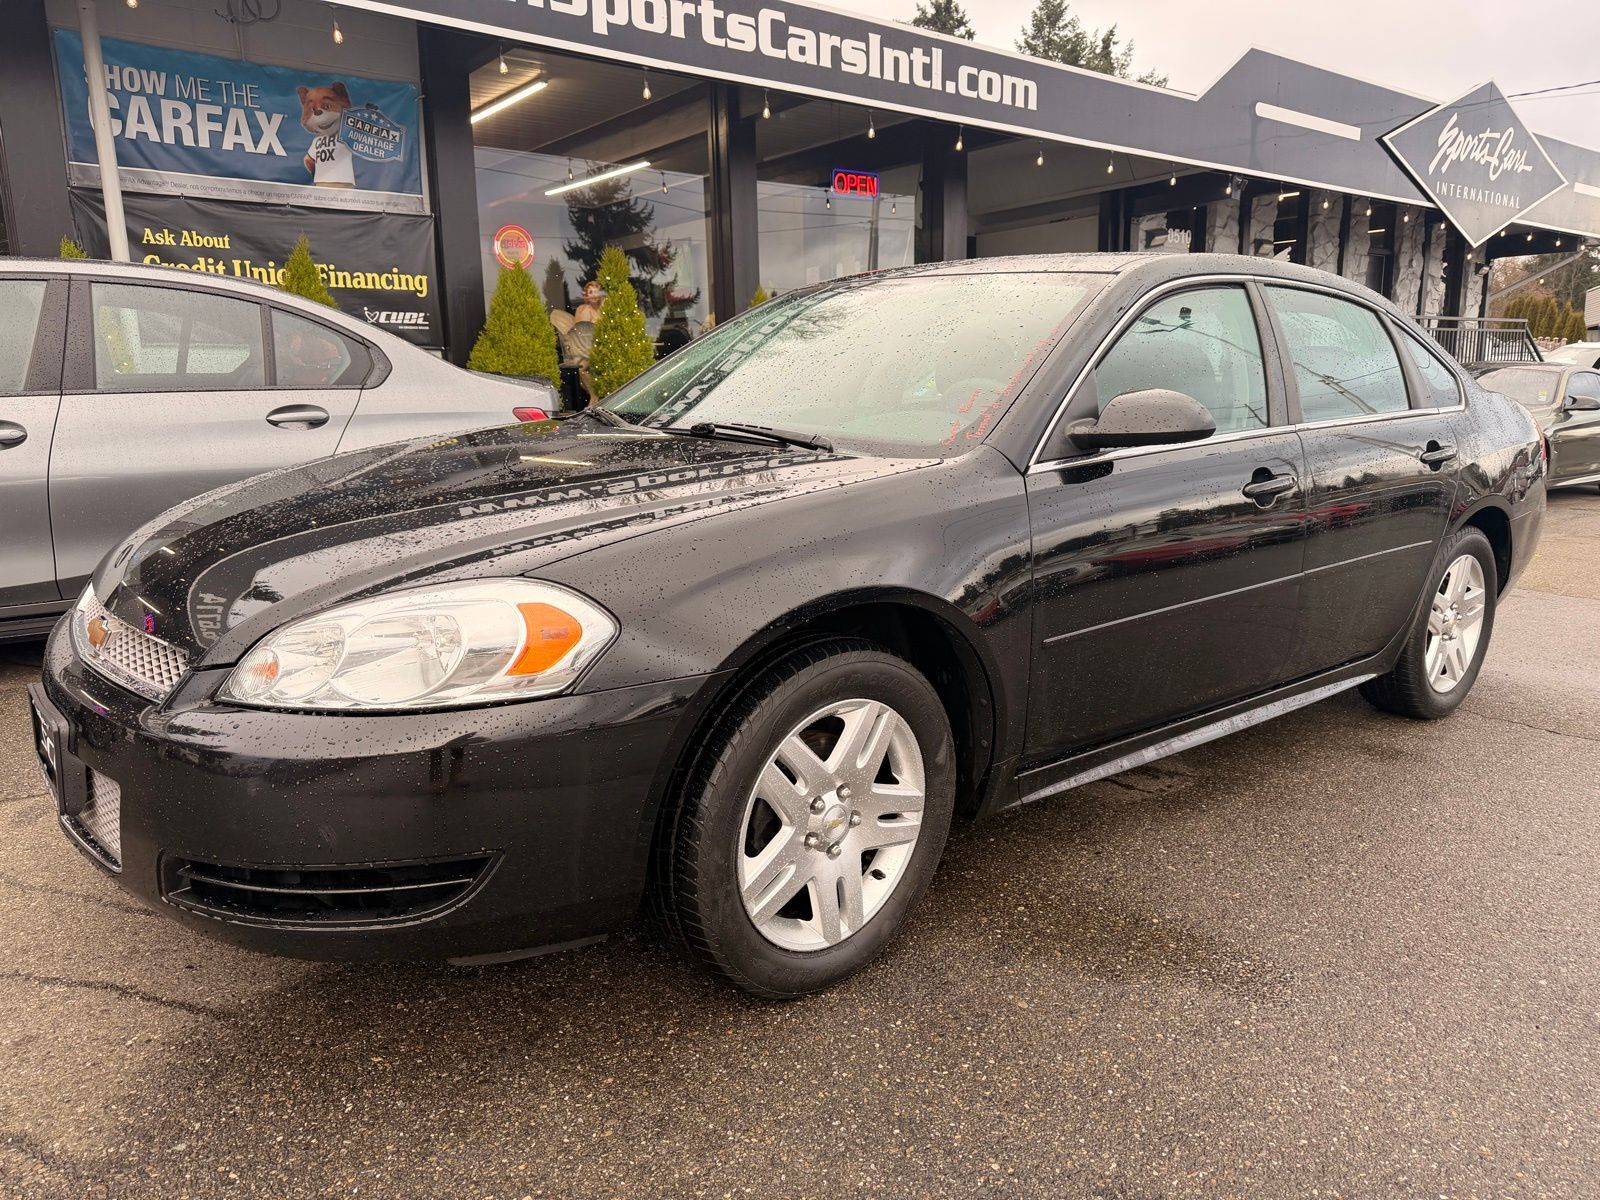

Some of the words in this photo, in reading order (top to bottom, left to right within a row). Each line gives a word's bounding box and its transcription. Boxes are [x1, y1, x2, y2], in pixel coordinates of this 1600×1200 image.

[83, 63, 167, 96] HOW
[175, 74, 212, 102] ME
[216, 80, 261, 108] THE
[346, 116, 400, 143] CARFAX
[315, 136, 336, 150] CAR
[348, 130, 394, 151] ADVANTAGE
[353, 141, 385, 158] DEALER
[315, 148, 336, 163] FOX
[834, 172, 877, 198] OPEN
[1436, 181, 1521, 209] INTERNATIONAL
[142, 228, 177, 246] Ask
[180, 230, 231, 249] About
[231, 258, 292, 286] Unio
[313, 263, 428, 298] Financing
[379, 311, 429, 325] CUDL
